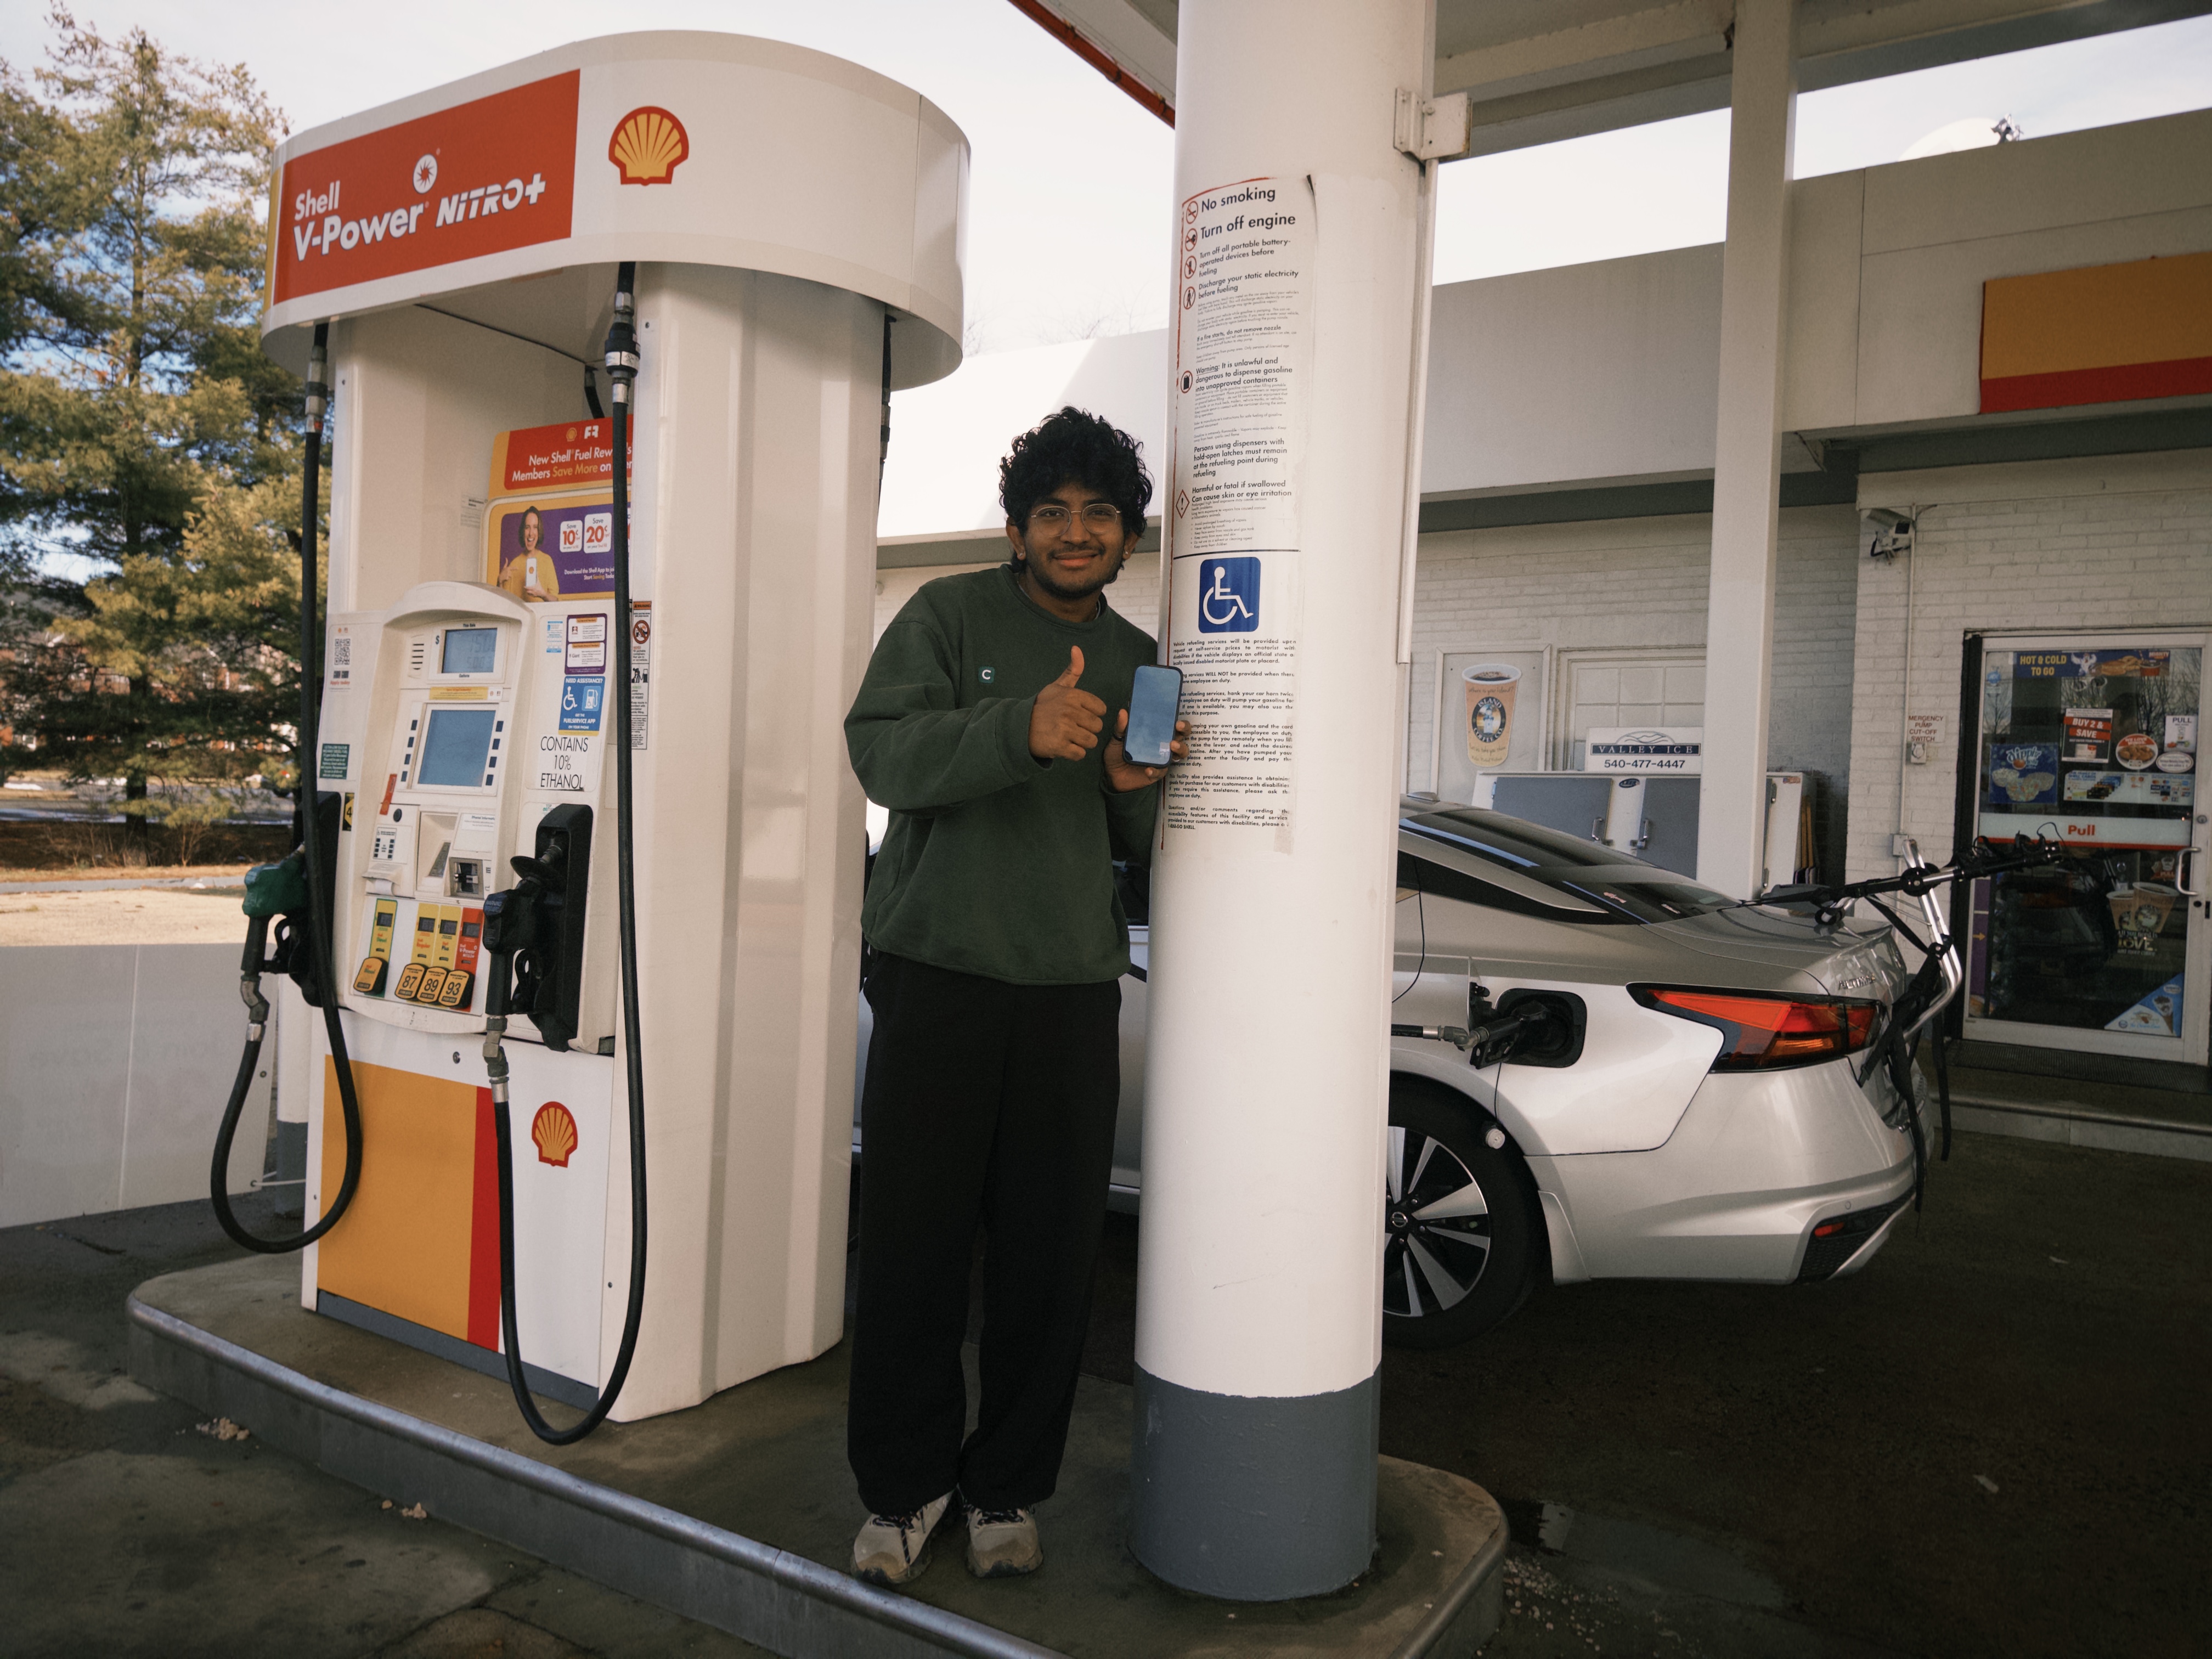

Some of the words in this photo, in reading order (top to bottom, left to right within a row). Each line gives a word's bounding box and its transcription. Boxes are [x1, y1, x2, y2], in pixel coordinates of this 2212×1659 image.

[295, 180, 340, 221] Shell
[1201, 200, 1216, 212] No
[1221, 188, 1276, 206] smoking
[294, 202, 424, 262] V-Power
[1200, 225, 1222, 239] Turn
[1227, 216, 1244, 232] off
[1249, 213, 1295, 229] engine
[1200, 251, 1210, 259] Turn
[1232, 240, 1259, 251] portable
[1200, 256, 1223, 268] operated
[1226, 252, 1249, 261] devices
[1199, 268, 1217, 278] fueling
[1199, 279, 1225, 290] Discharge
[1228, 276, 1242, 284] your
[1199, 290, 1215, 298] before
[1217, 285, 1238, 295] fueling
[1196, 365, 1220, 374] Warning:
[1234, 358, 1262, 366] unlawful
[1196, 374, 1223, 384] dangerous
[1233, 367, 1261, 376] dispense
[1206, 380, 1241, 390] unapproved
[1194, 444, 1213, 453] Persons
[1233, 439, 1267, 449] dispensers
[529, 455, 549, 466] New
[551, 449, 571, 464] Shell
[574, 447, 592, 460] Fuel
[1194, 453, 1220, 461] hold-open
[1209, 459, 1234, 467] refueling
[512, 468, 550, 482] Members
[552, 466, 573, 477] Save
[575, 463, 598, 475] More
[600, 463, 611, 472] on
[1193, 470, 1216, 478] refueling
[1192, 484, 1214, 493] Harmful
[436, 635, 439, 645] $
[2020, 656, 2036, 664] HOT
[2038, 656, 2044, 664] &
[2045, 656, 2067, 664] COLD
[981, 669, 991, 680] C
[2031, 667, 2041, 675] TO
[2043, 667, 2055, 675] GO
[1478, 698, 1502, 709] ISLAND
[2072, 718, 2089, 727] BUY
[2090, 720, 2095, 728] 2
[1474, 728, 1494, 742] COFFEE
[1495, 728, 1504, 738] CO.
[2076, 729, 2097, 738] SAVE
[541, 736, 589, 752] CONTAINS
[554, 755, 571, 770] 10%
[1604, 759, 1685, 768] 540-477-4447
[540, 773, 584, 789] ETHANOL
[347, 807, 352, 817] 4
[2068, 825, 2096, 836] Pull
[402, 975, 417, 989] 87
[424, 978, 439, 992] 89
[445, 981, 461, 996] 93
